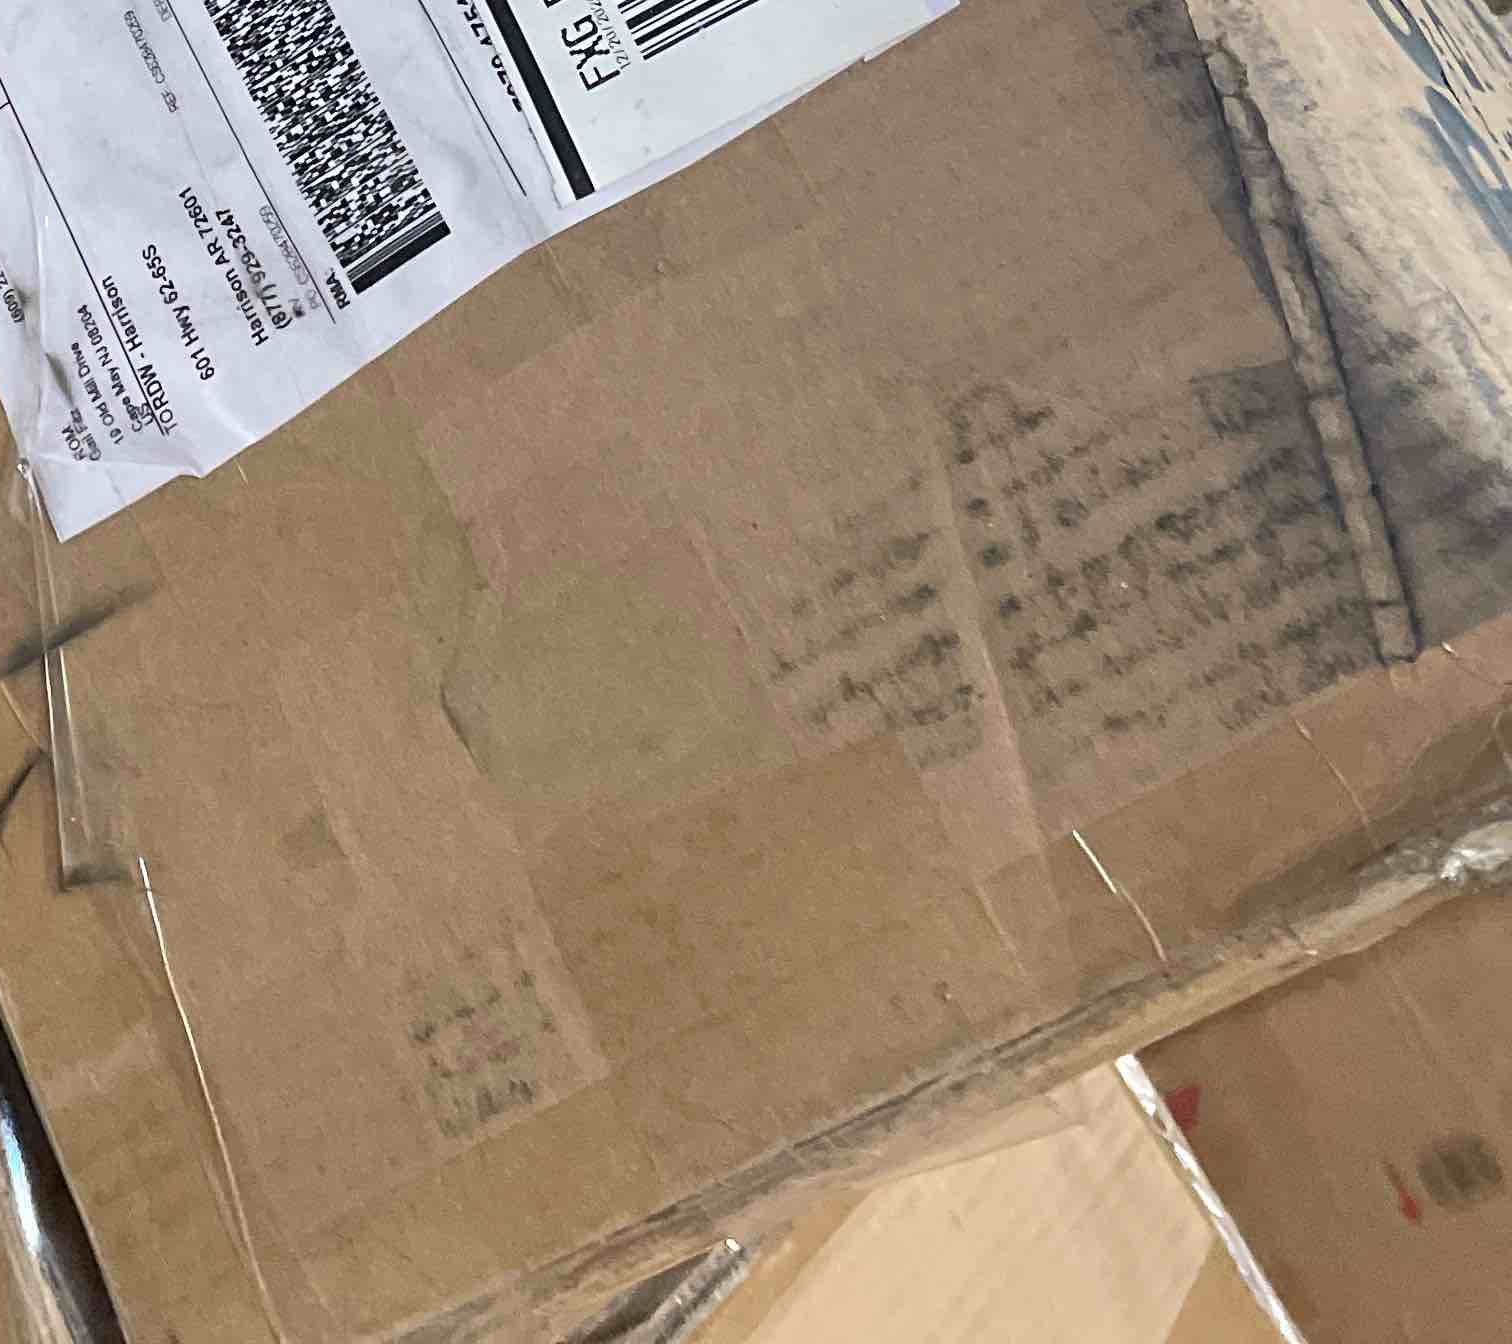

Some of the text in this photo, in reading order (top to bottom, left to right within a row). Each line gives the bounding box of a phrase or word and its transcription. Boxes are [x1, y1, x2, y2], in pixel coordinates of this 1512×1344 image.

[560, 14, 621, 92] FXG
[178, 186, 270, 347] Harrison AR 72601
[215, 208, 294, 330] (877) 929-3247
[2, 287, 27, 324] (609)
[100, 276, 144, 353] Harrison
[142, 244, 215, 381] 601 Hwy 62-65S
[70, 342, 91, 379] Drive
[77, 304, 143, 432] Cape May NJ 08204
[137, 364, 169, 411] RDW
[62, 424, 88, 461] ROM
[95, 401, 115, 427] Old
[138, 402, 155, 427] US
